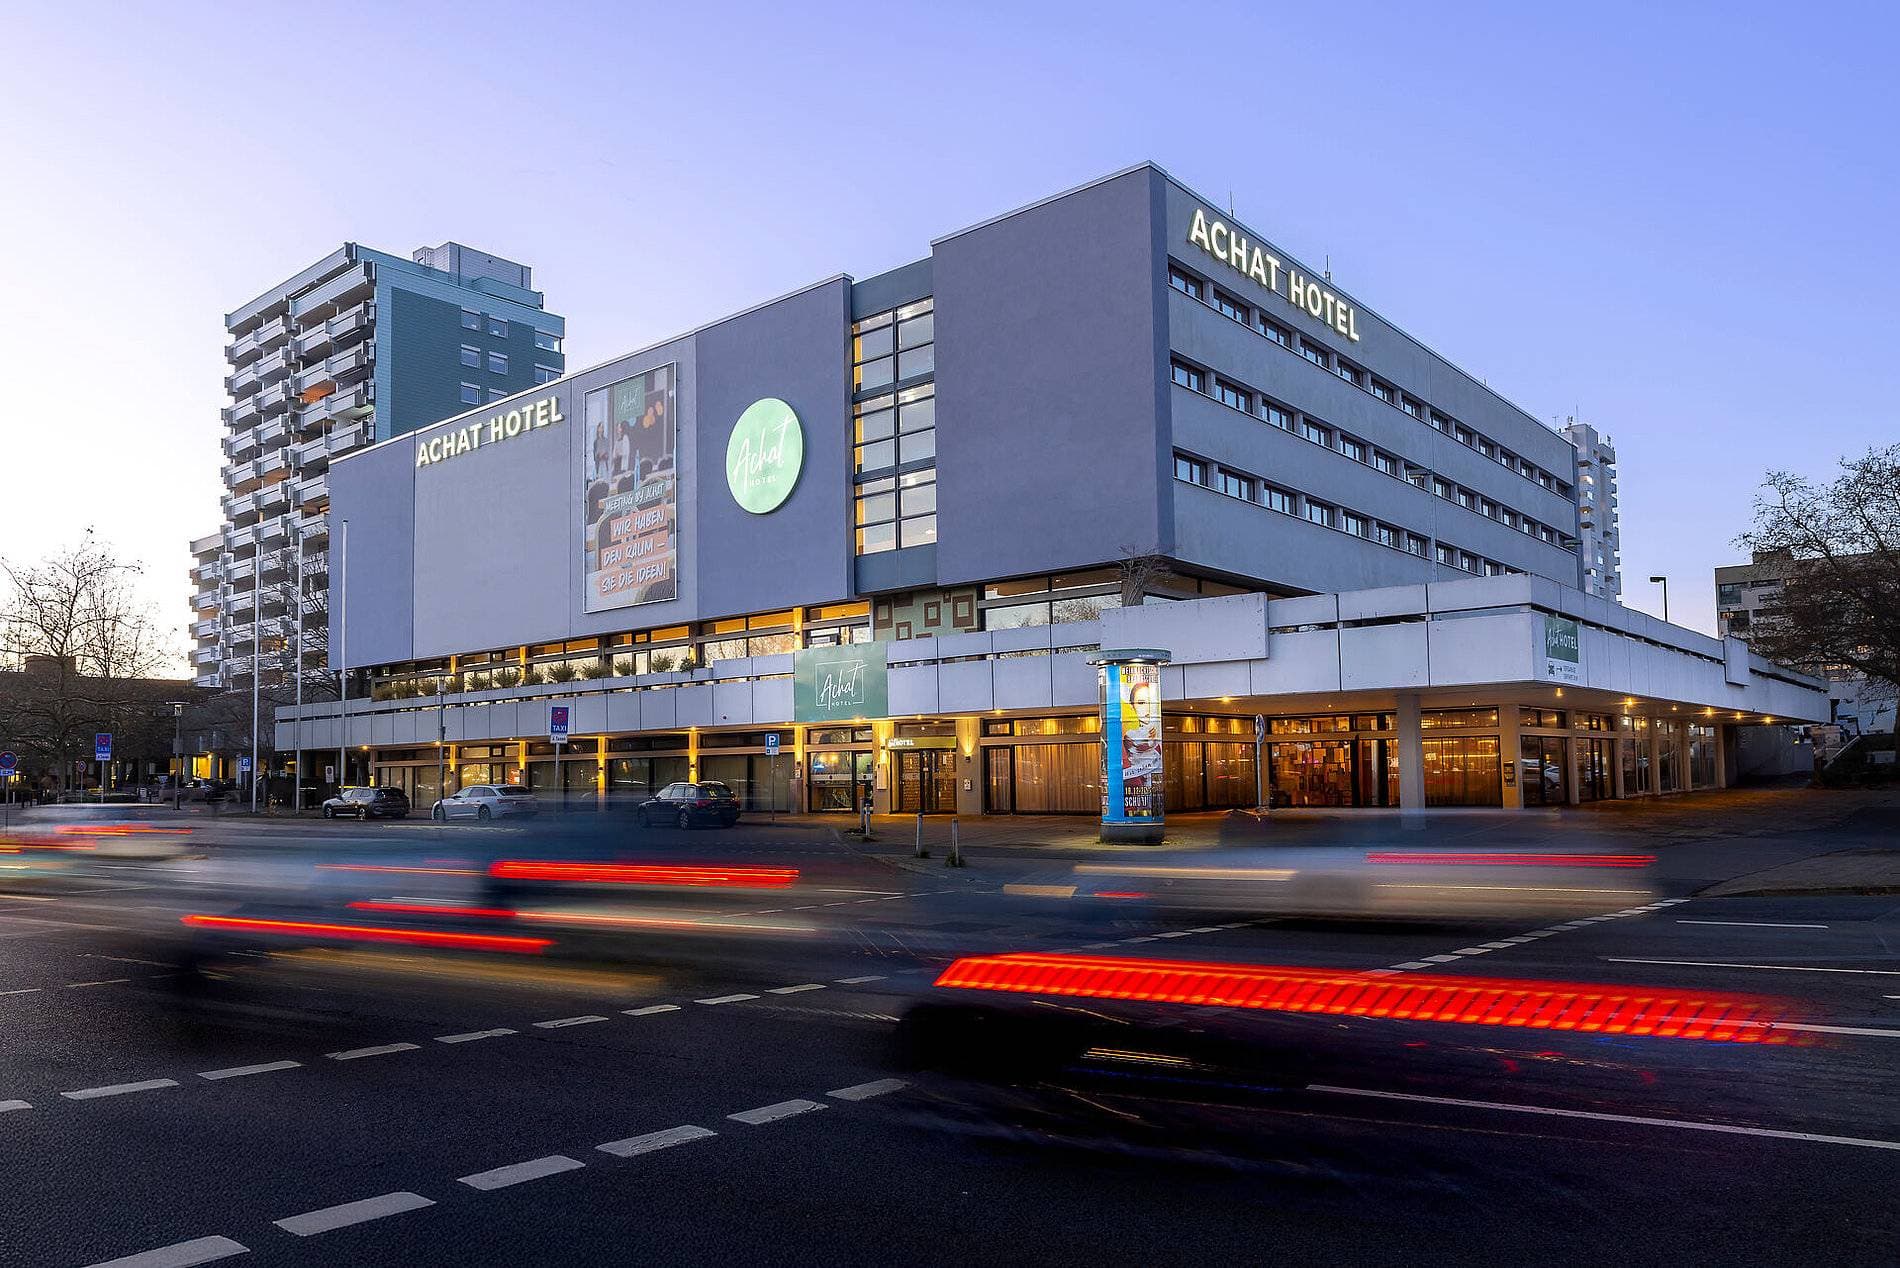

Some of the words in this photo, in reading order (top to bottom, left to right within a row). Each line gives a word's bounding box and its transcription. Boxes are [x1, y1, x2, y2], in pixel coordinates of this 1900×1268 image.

[1188, 208, 1280, 291] ACHAT
[1288, 269, 1360, 342] HOTEL
[416, 423, 483, 467] ACHAT
[490, 395, 564, 443] HOTEL
[733, 414, 796, 495] Achat
[613, 518, 632, 536] WIR
[635, 509, 664, 531] HABEN
[603, 547, 622, 567] DEN
[626, 538, 654, 559] RAUM
[601, 577, 616, 593] SIE
[619, 570, 634, 588] DIE
[636, 561, 667, 583] IDEEN!
[1560, 634, 1578, 650] HOTEL
[820, 662, 869, 711] Achat
